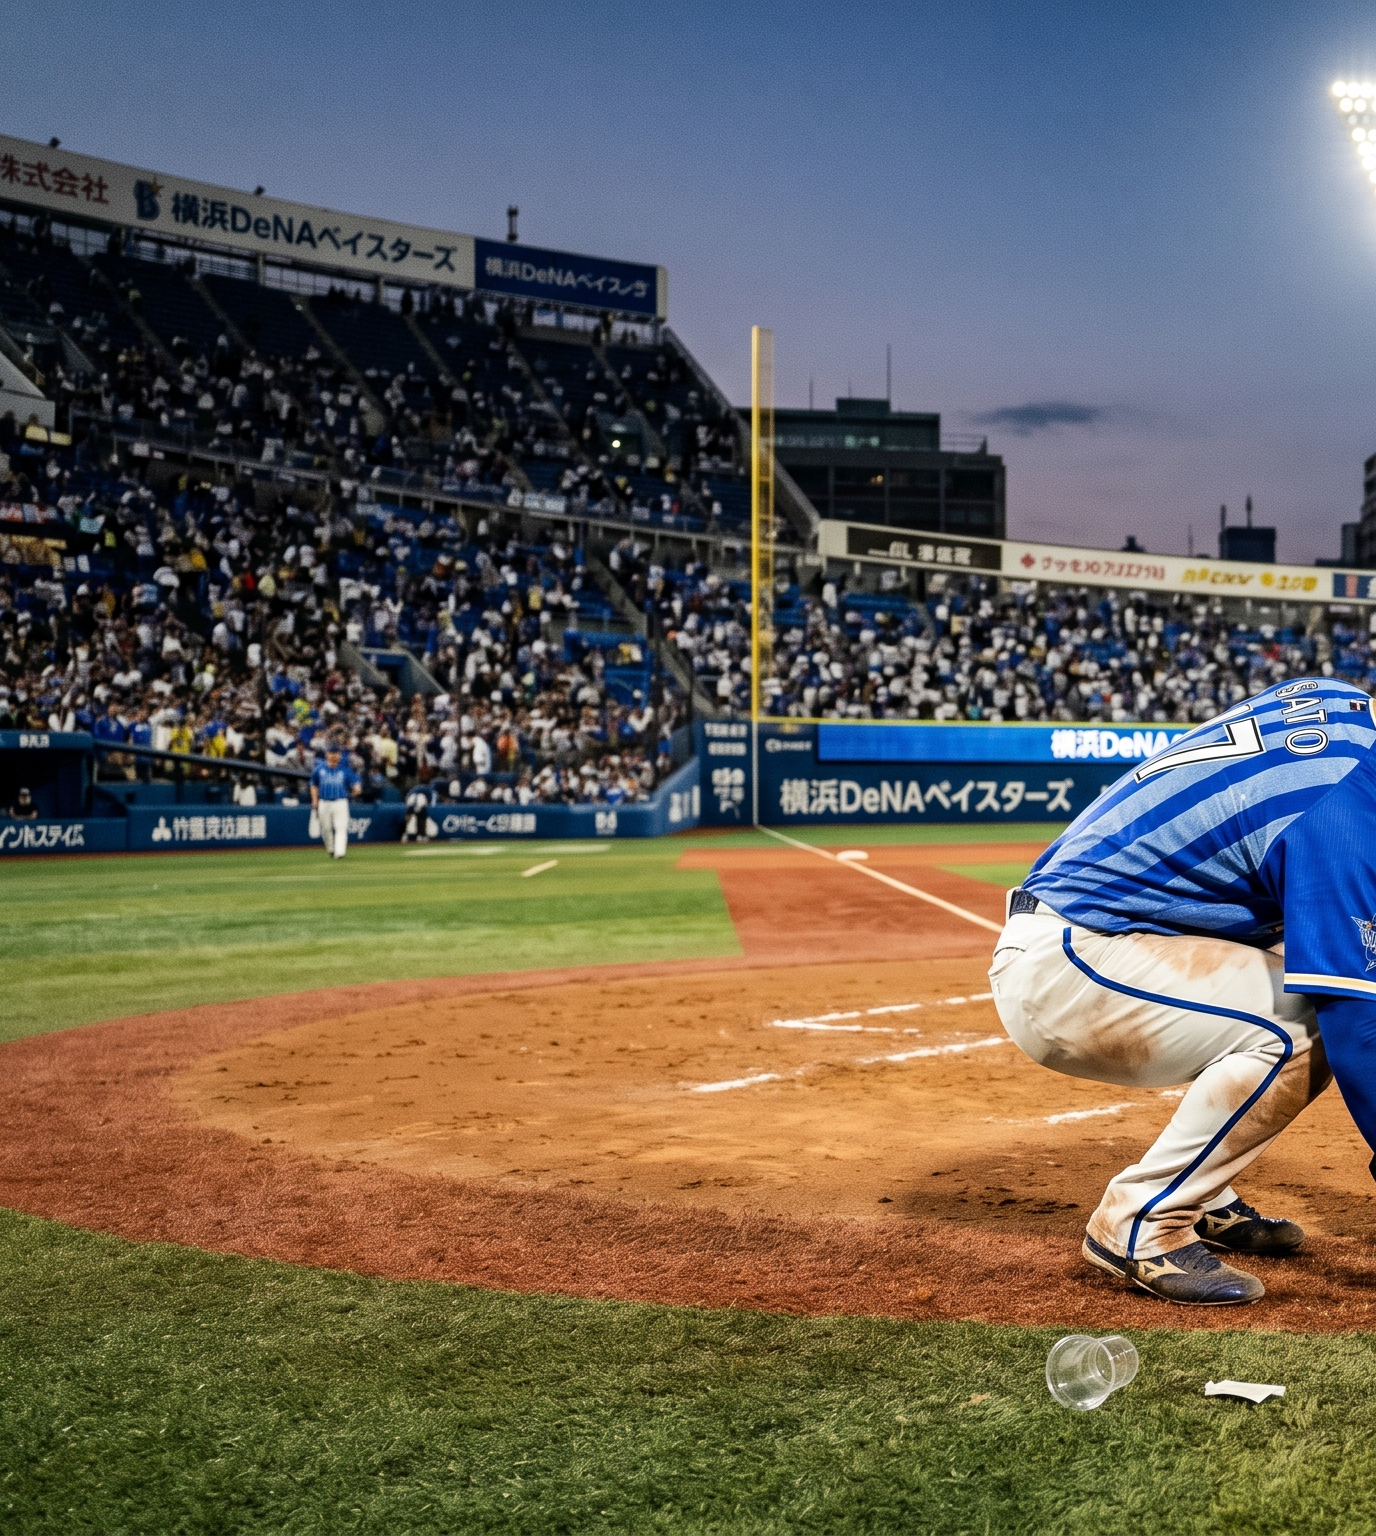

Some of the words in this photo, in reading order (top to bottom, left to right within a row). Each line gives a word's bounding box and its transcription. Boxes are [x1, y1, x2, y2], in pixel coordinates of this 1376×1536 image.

[0, 153, 109, 205] 株式会社
[171, 191, 457, 273] 横浜DeNAベイスターズ
[1133, 693, 1268, 784] 17
[1275, 680, 1330, 756] SATO
[779, 778, 1075, 815] 横浜DeNAベイスターズ
